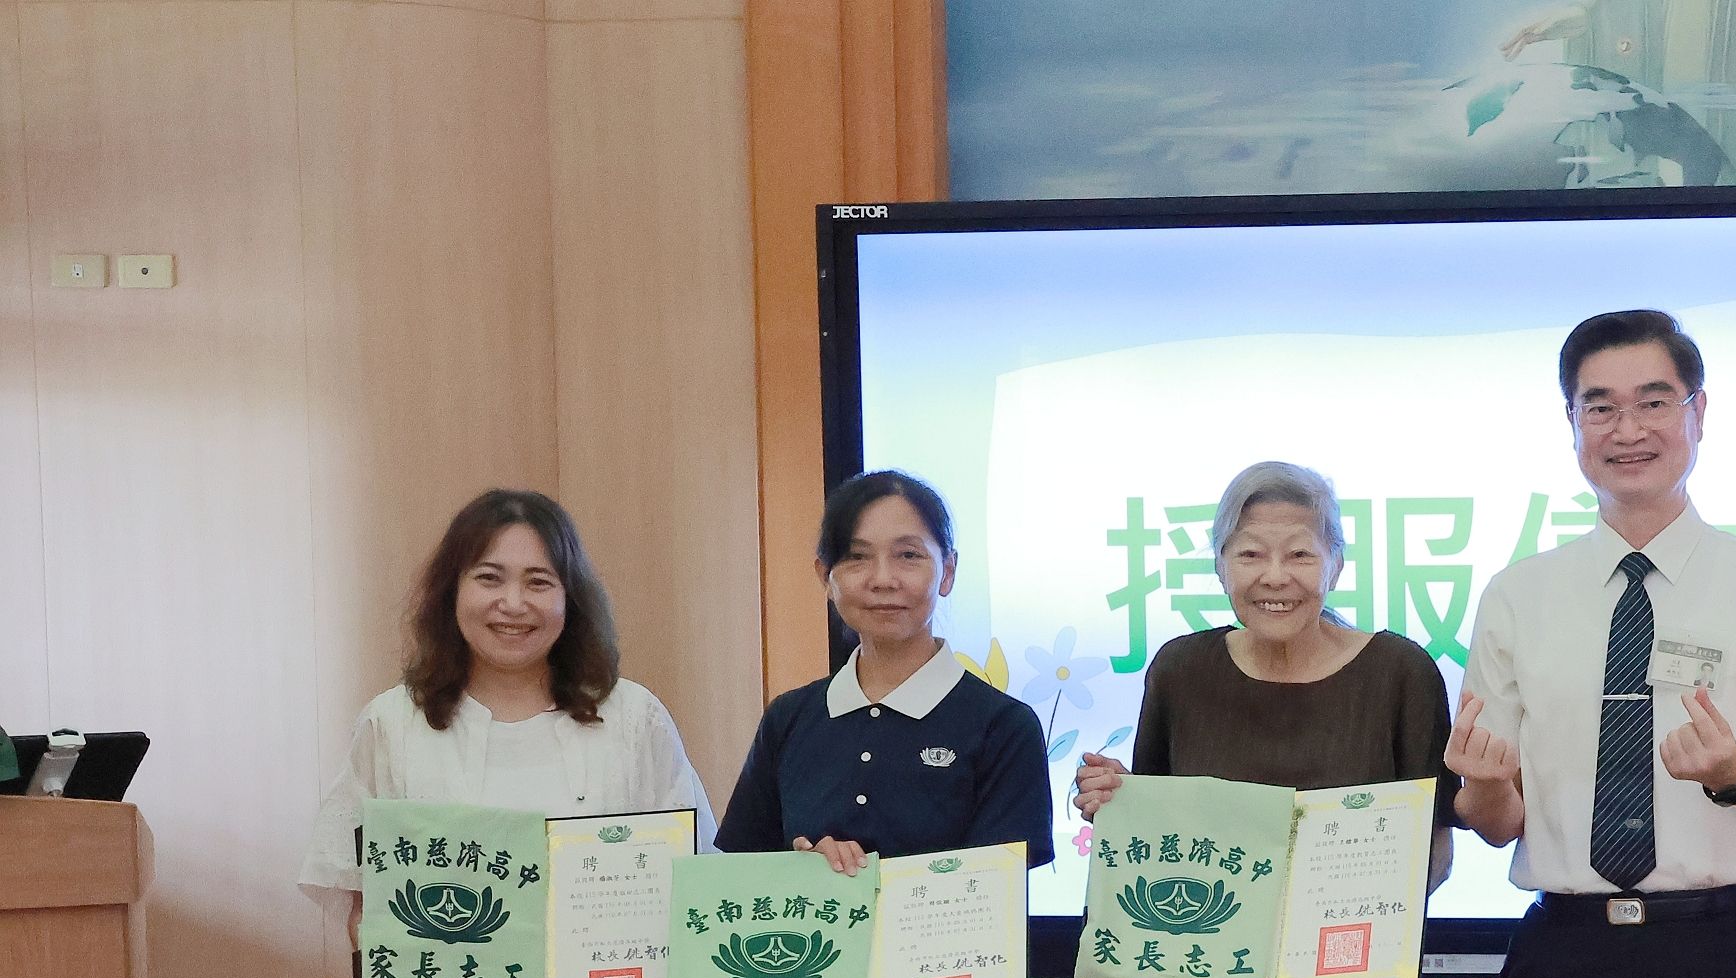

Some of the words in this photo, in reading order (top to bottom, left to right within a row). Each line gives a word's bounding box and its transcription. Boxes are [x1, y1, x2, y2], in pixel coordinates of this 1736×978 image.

[833, 205, 889, 219] JECTOR
[1323, 816, 1388, 837] 聘書
[367, 836, 541, 888] 臺南慈濟高中
[583, 852, 648, 873] 聘書
[1098, 833, 1273, 884] 臺南慈濟高中
[911, 878, 980, 899] 聘書
[685, 895, 870, 935] 臺南慈濟高中
[1092, 928, 1256, 978] 家長志工
